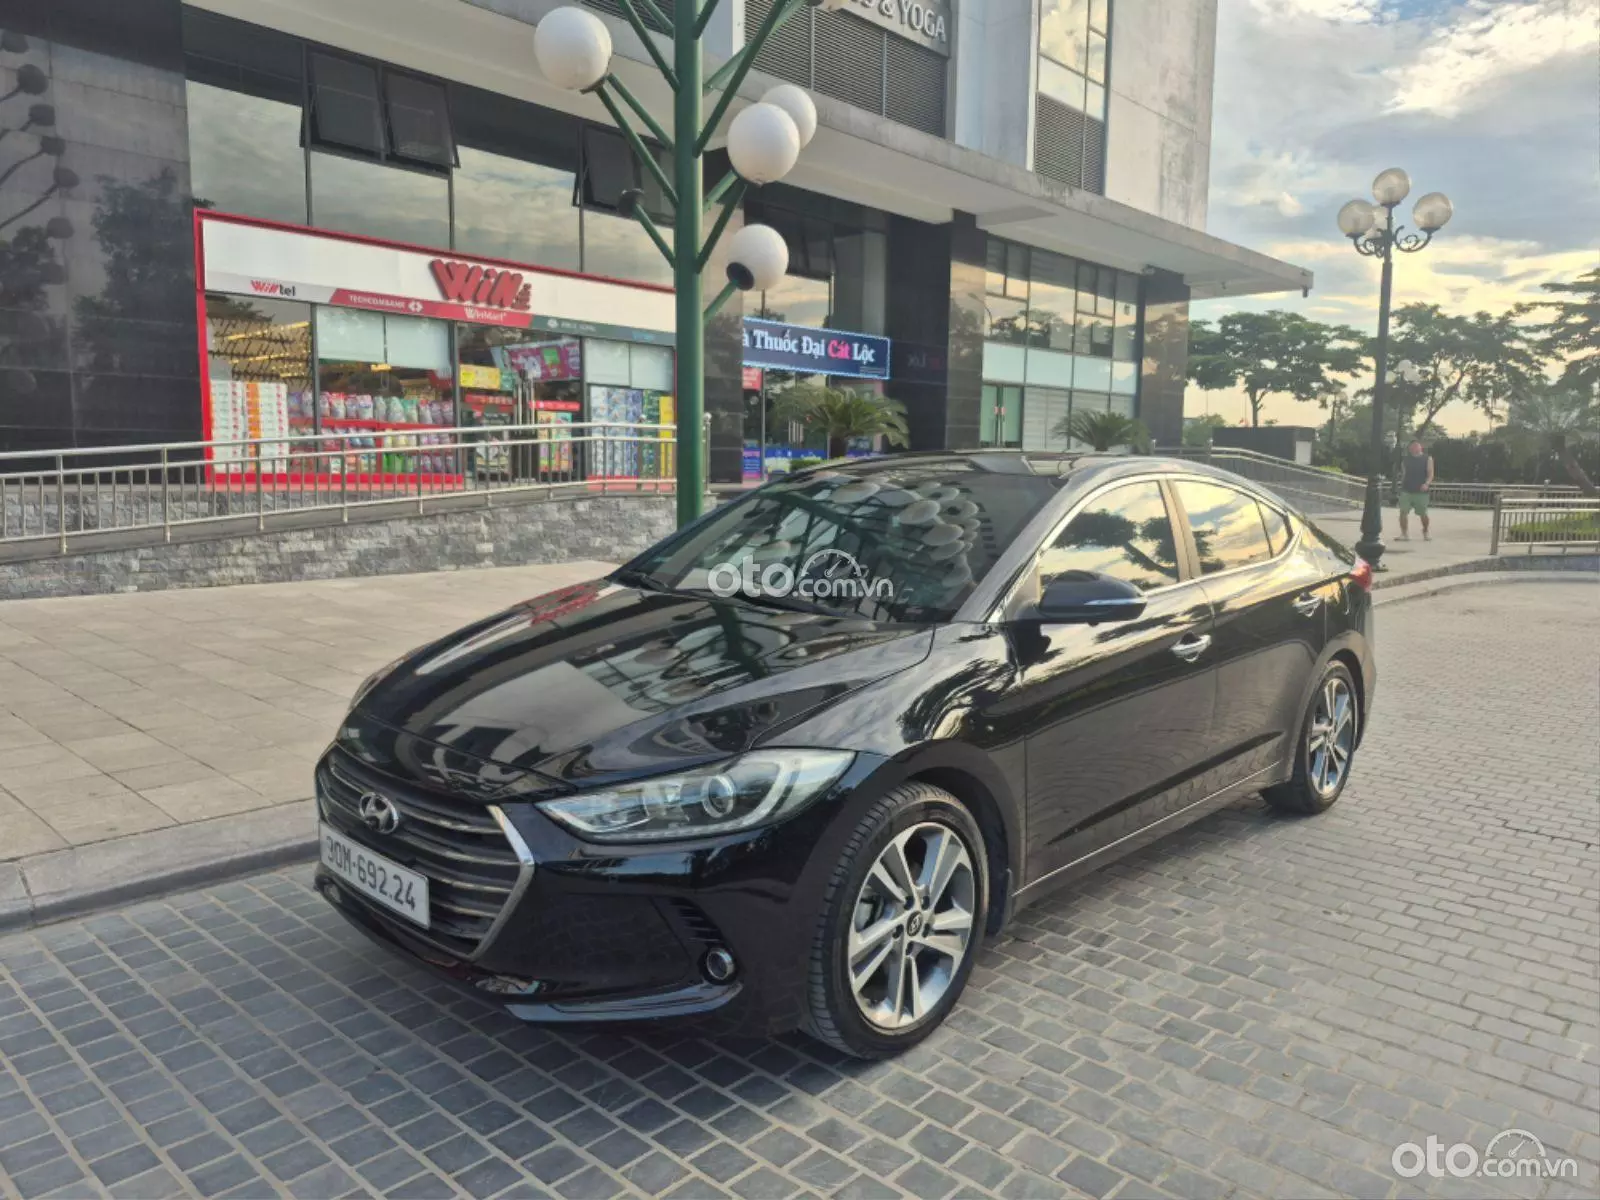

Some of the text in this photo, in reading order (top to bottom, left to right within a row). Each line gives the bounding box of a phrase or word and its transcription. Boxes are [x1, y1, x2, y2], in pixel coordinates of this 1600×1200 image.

[901, 0, 946, 42] YOGA
[753, 328, 798, 354] Thuốc
[801, 336, 825, 360] Đại
[827, 339, 850, 359] Cát
[853, 342, 875, 365] Lộc
